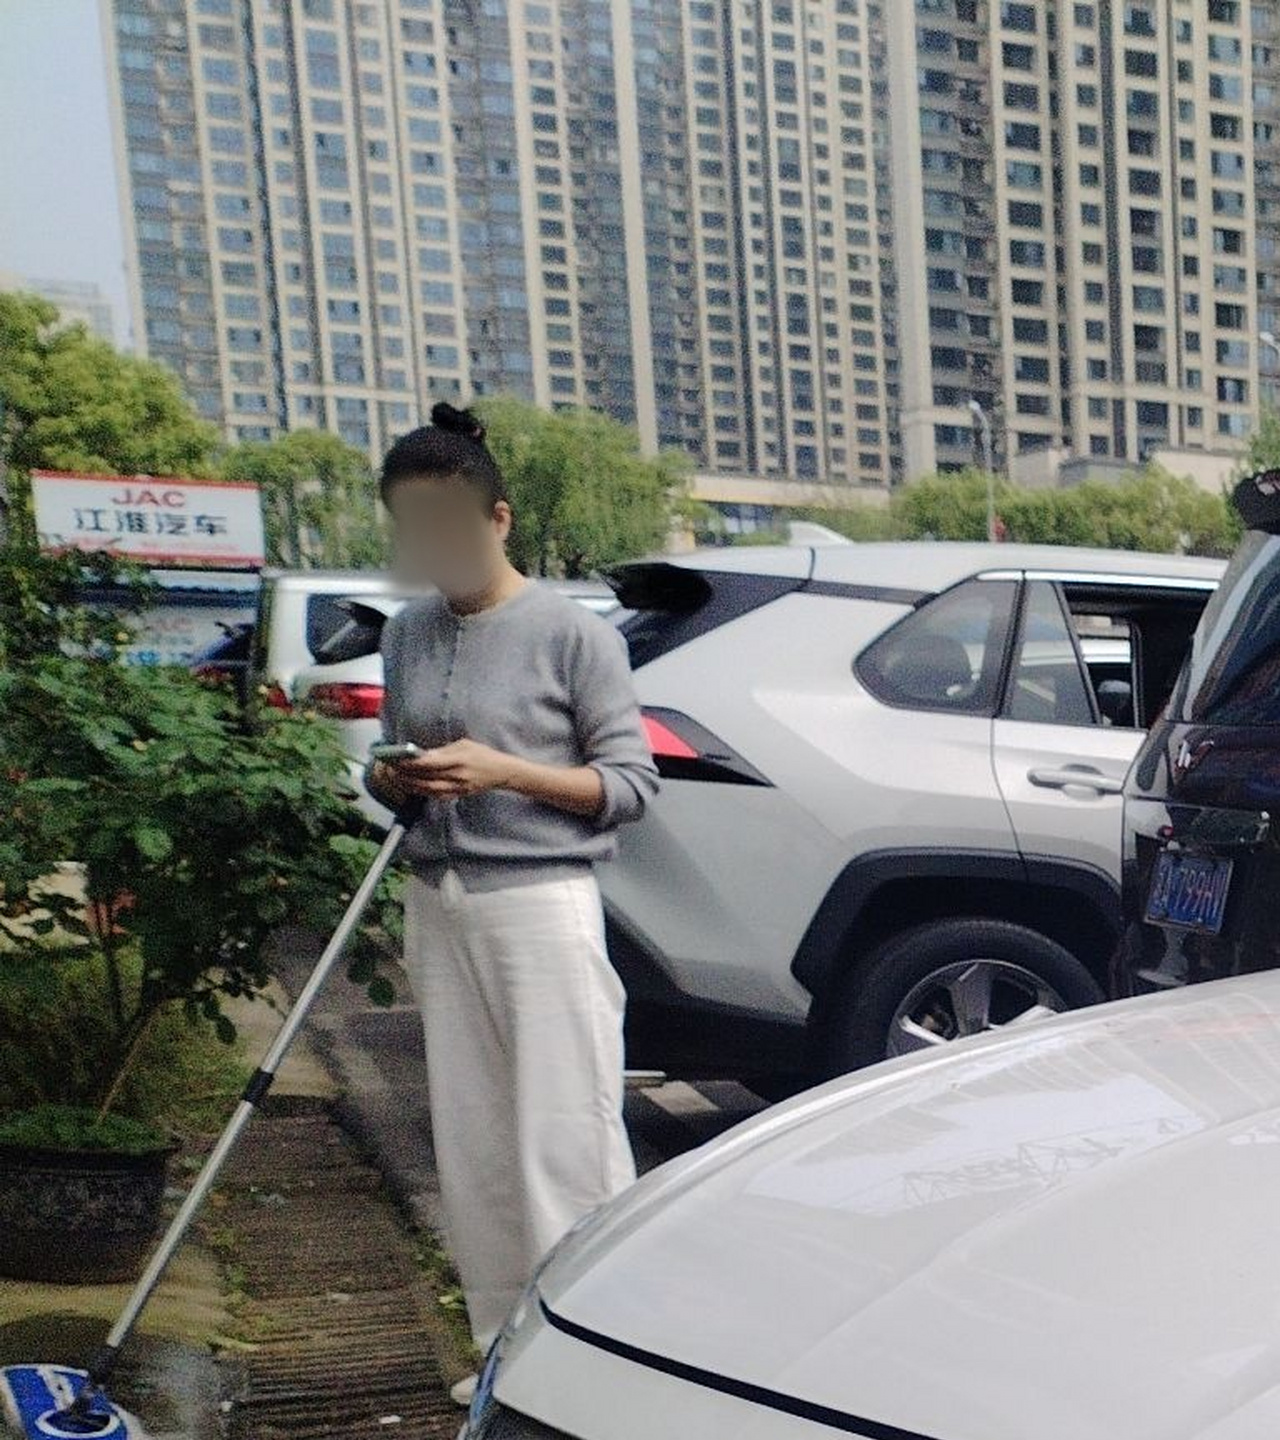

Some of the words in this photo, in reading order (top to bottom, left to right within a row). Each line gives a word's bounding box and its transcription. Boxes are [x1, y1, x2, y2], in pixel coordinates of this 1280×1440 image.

[111, 489, 186, 507] JAC
[73, 508, 227, 536] 江淮汽车
